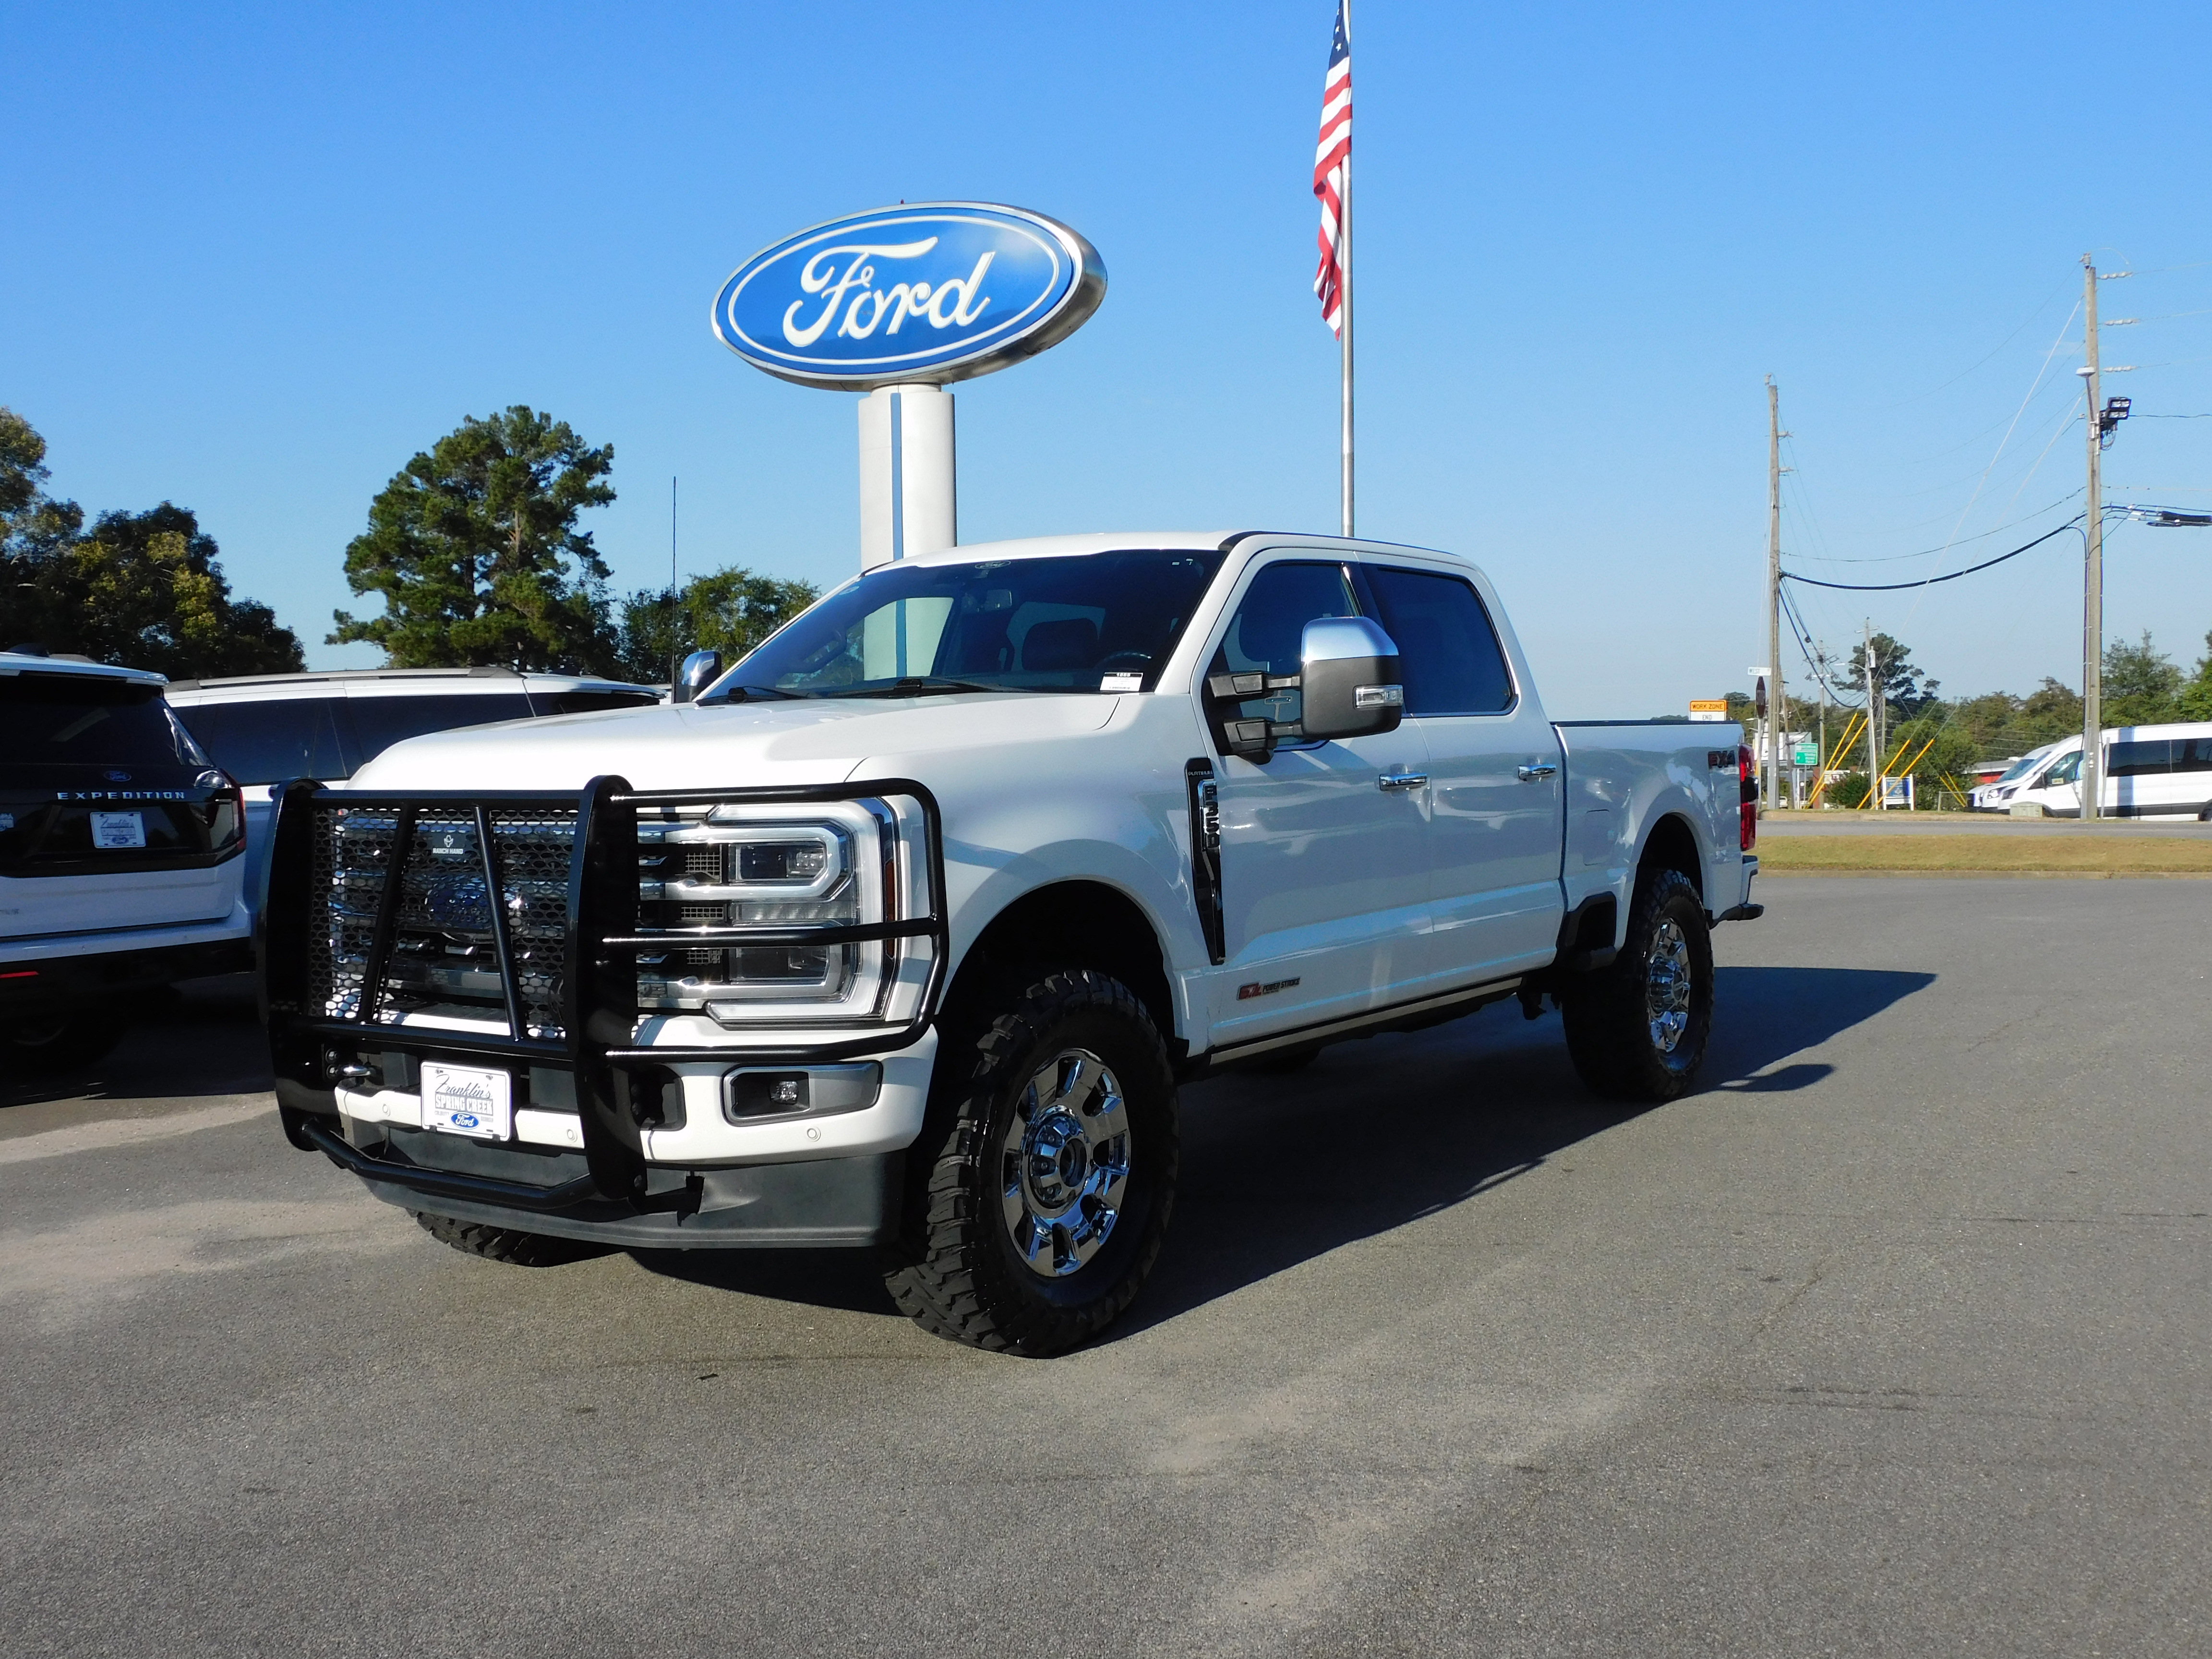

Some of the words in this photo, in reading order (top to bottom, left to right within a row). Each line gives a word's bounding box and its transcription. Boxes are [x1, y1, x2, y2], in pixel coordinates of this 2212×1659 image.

[782, 236, 996, 348] Ford
[57, 792, 185, 800] EXPEDITION
[1262, 982, 1280, 993] POWER
[435, 1074, 493, 1099] Franklin's
[436, 1094, 466, 1111] SPRING
[466, 1098, 493, 1115] CREEK
[455, 1113, 474, 1127] Ford
